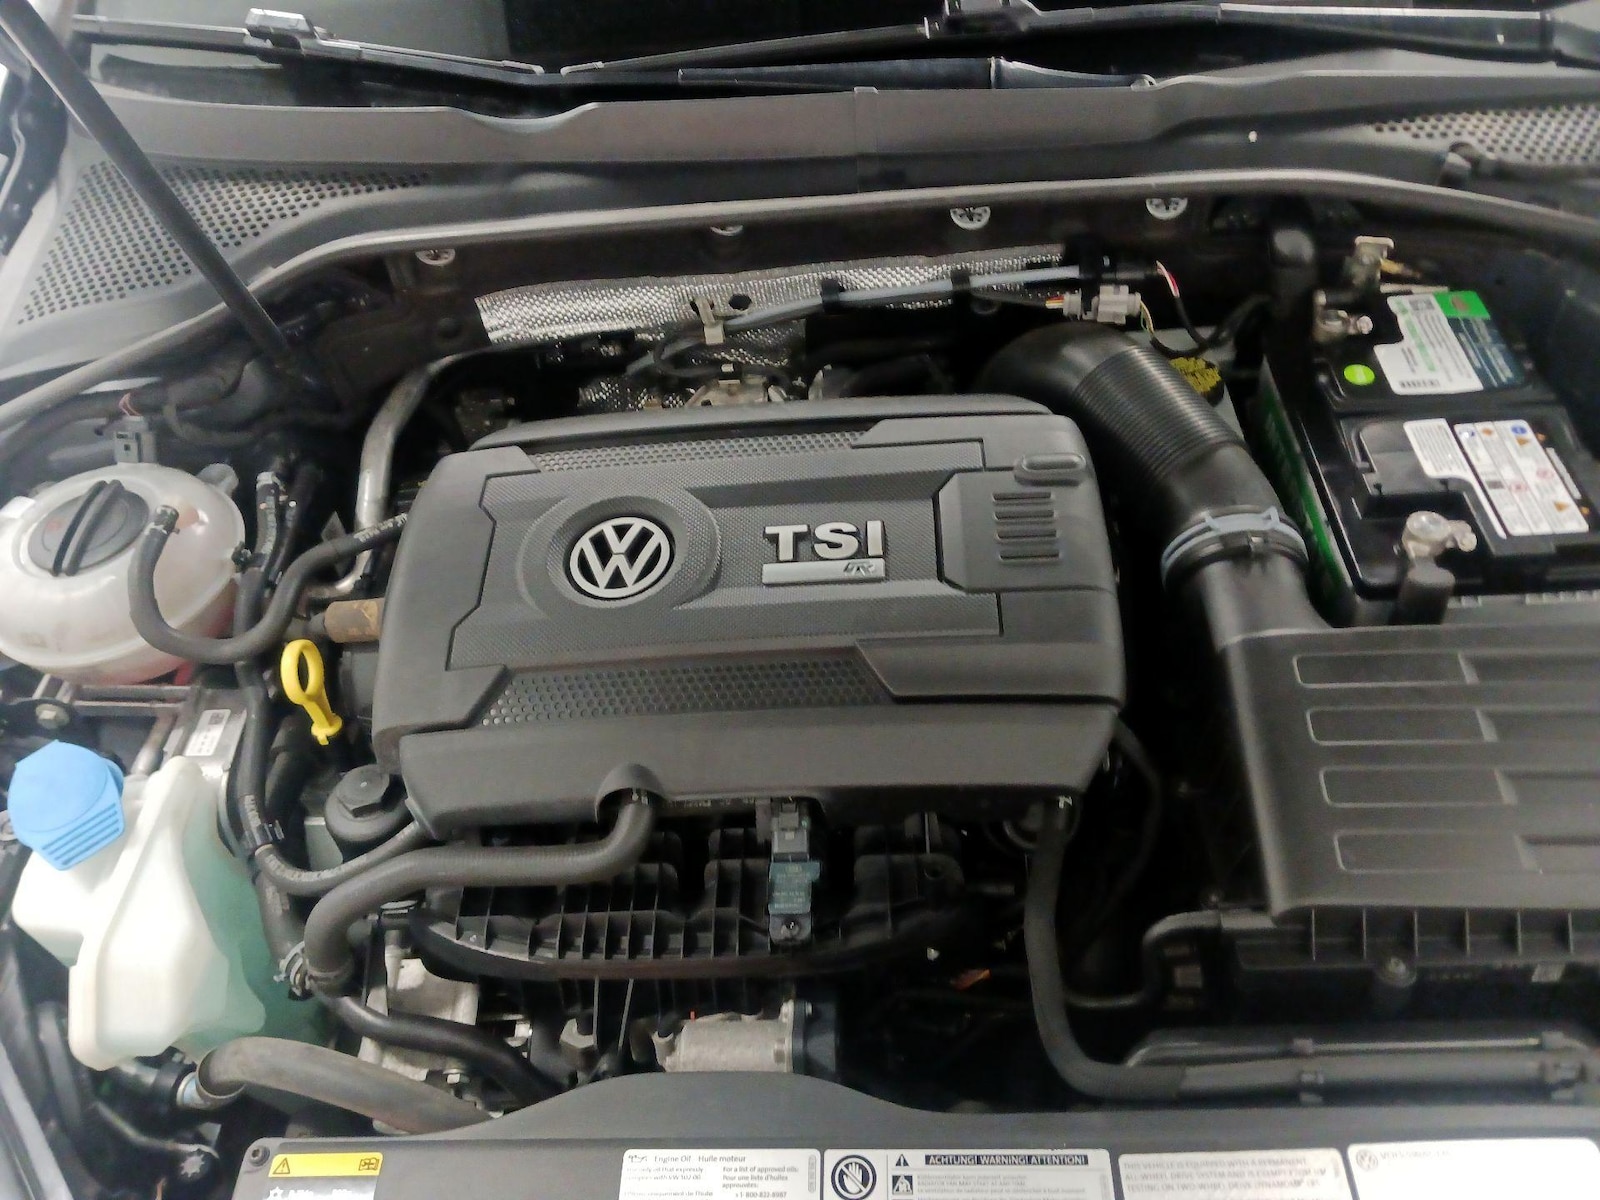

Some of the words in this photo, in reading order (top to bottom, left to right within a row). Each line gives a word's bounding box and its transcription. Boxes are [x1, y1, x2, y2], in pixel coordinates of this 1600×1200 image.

[764, 520, 885, 562] TSI
[569, 516, 671, 600] VW
[654, 1155, 679, 1164] Engine
[928, 1155, 977, 1165] ACHTUNG!
[979, 1155, 1029, 1165] WARNING!
[1030, 1155, 1086, 1165] ATTENTION!
[757, 1166, 786, 1174] approved
